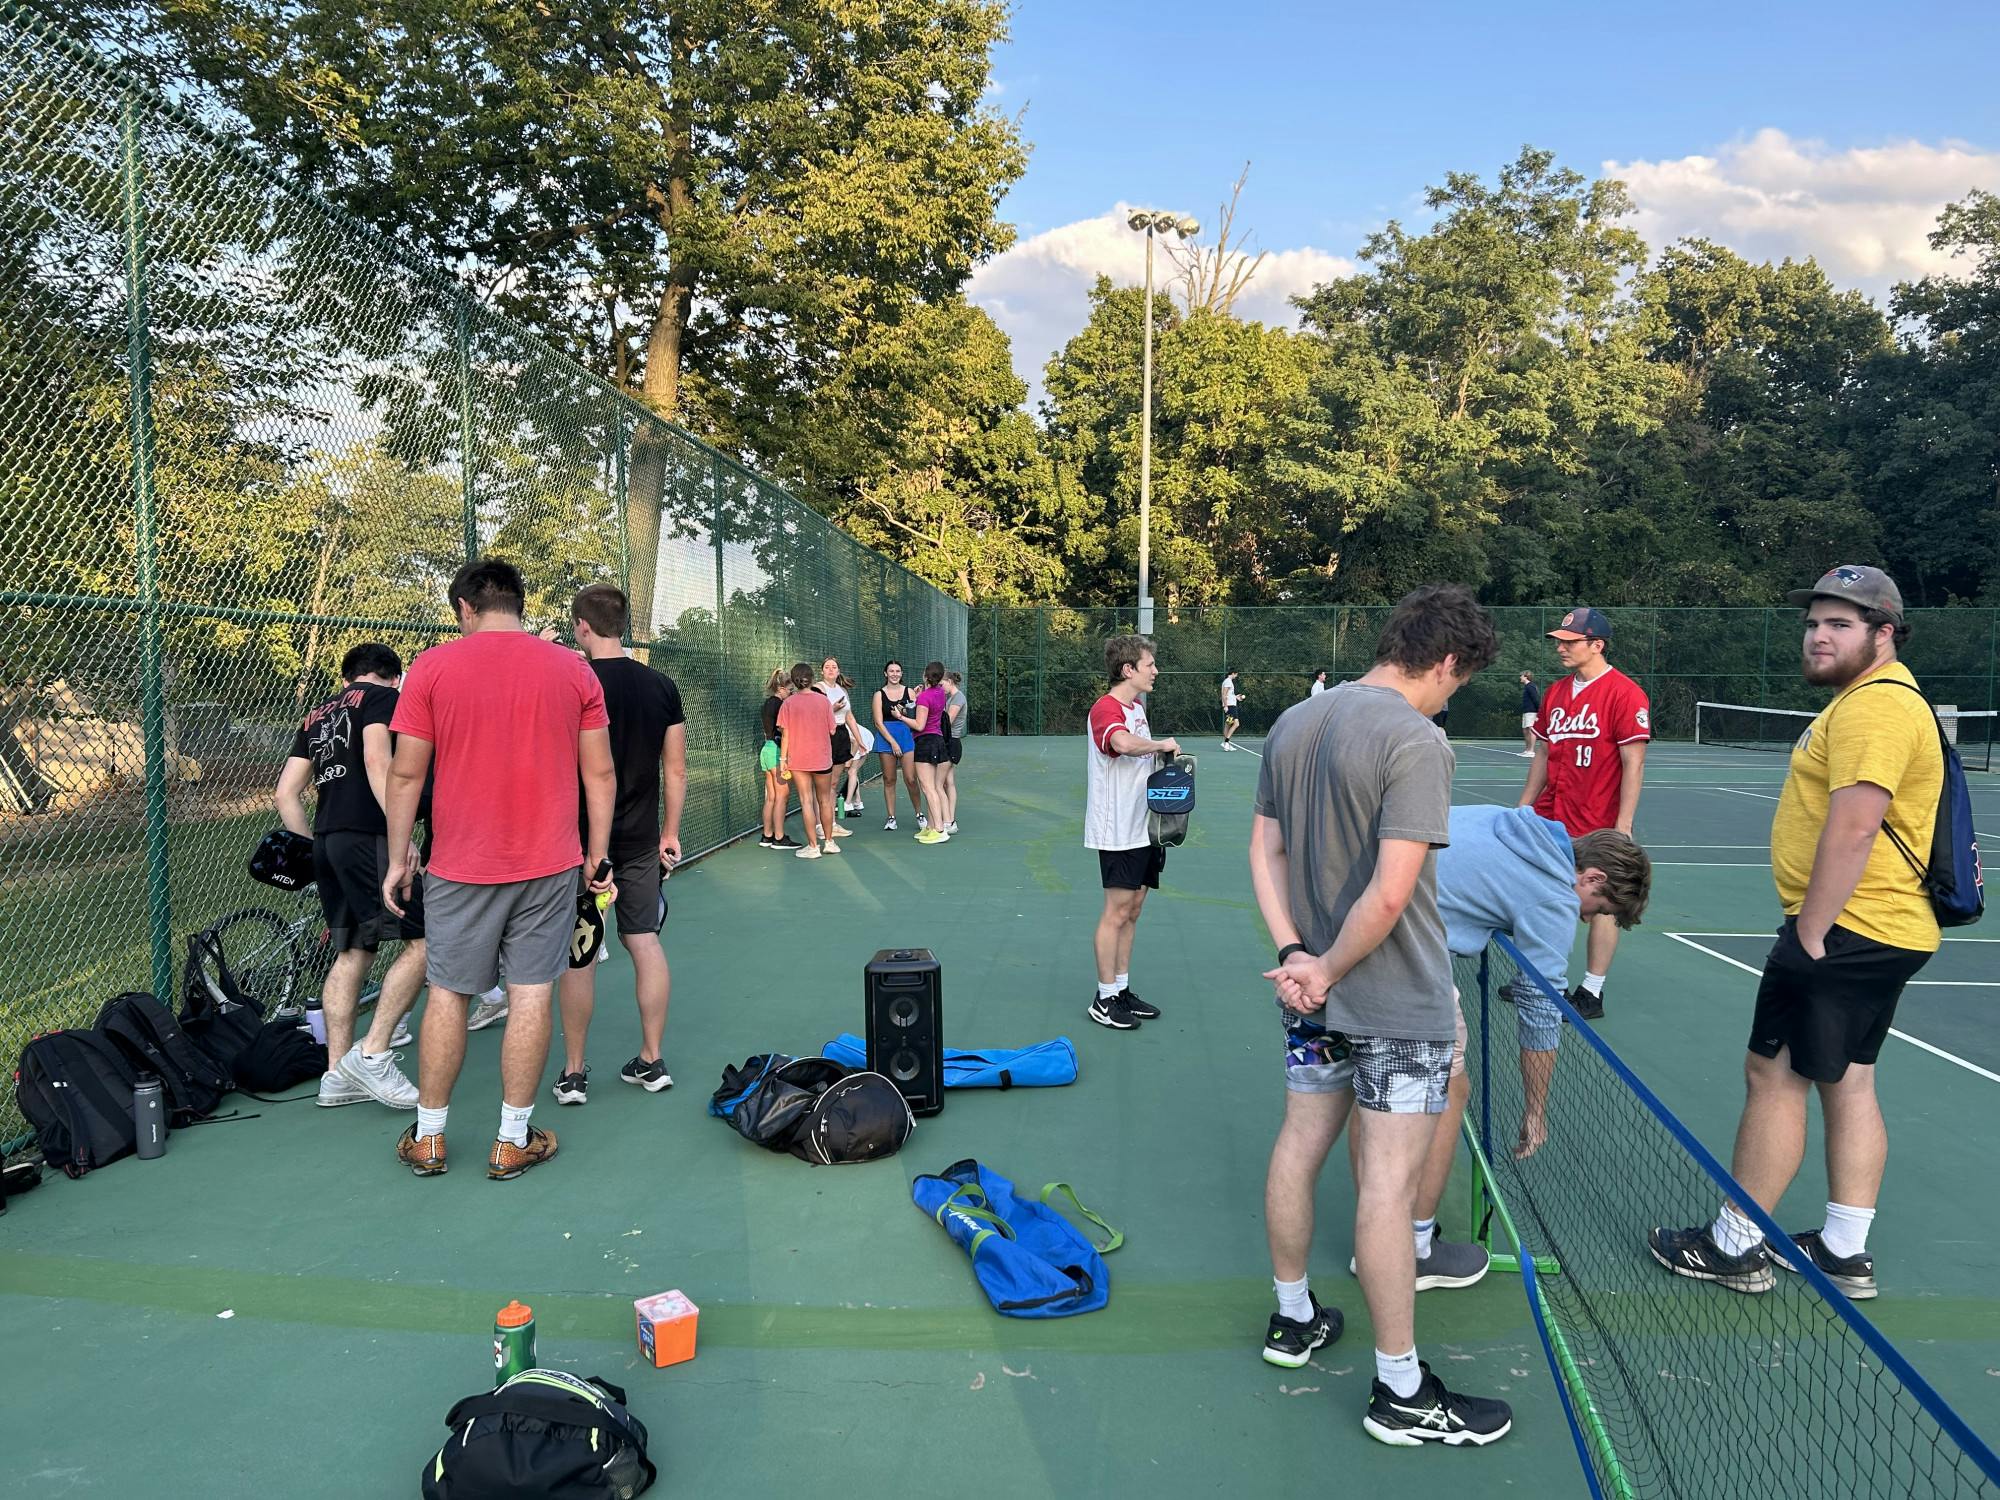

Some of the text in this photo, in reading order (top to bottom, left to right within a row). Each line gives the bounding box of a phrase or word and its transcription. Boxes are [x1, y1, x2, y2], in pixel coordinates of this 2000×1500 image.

[1546, 703, 1600, 743] Reds
[1575, 744, 1593, 767] 19
[1149, 789, 1186, 798] SLK
[1681, 1249, 1706, 1267] N
